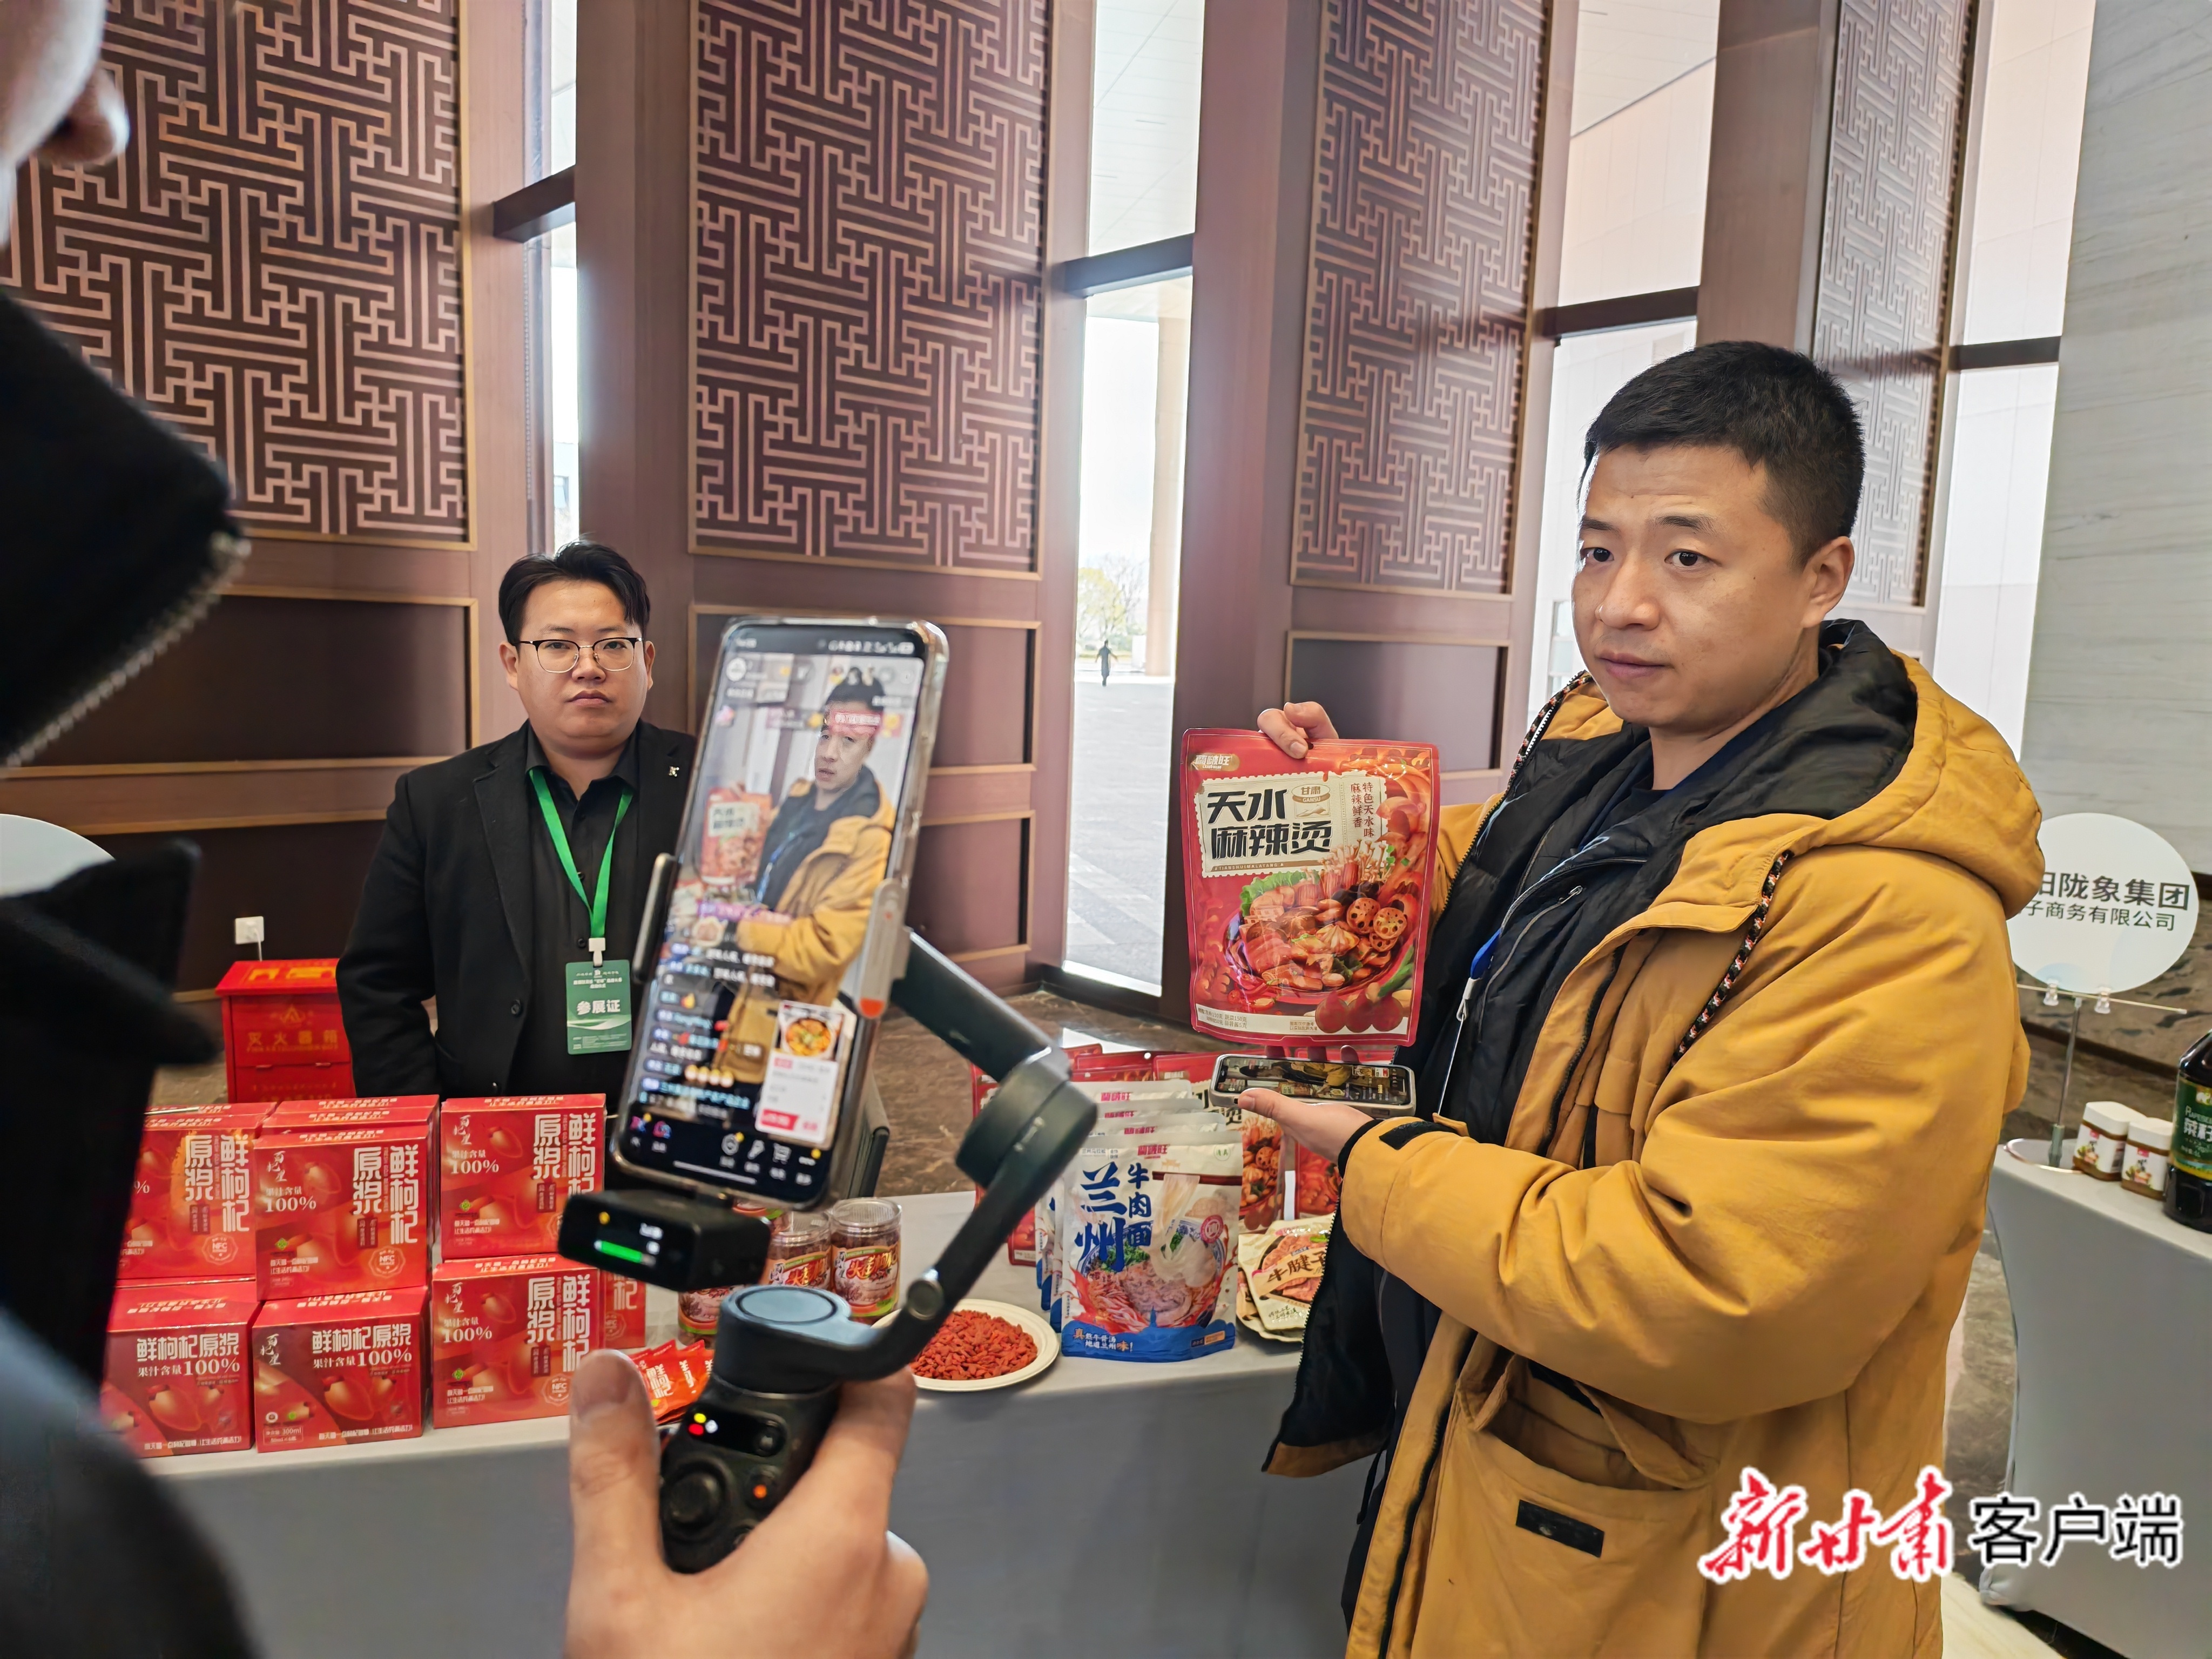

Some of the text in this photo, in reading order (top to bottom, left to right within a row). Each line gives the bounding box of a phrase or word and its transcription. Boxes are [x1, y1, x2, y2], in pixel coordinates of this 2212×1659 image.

[1208, 789, 1287, 824] 天水
[1300, 786, 1321, 795] 甘肃
[1351, 783, 1363, 828] 麻辣鲜香
[1362, 782, 1374, 838] 特色天水味
[1211, 821, 1331, 859] 麻辣烫
[2019, 900, 2175, 931] 子商务有限公司
[577, 1000, 621, 1015] 参展证
[185, 1134, 213, 1201] 原浆
[451, 1160, 499, 1175] 100%
[532, 1114, 561, 1179] 原浆
[568, 1112, 596, 1195] 鲜枸杞
[221, 1134, 249, 1232] 鲜枸杞
[265, 1195, 316, 1212] 100%
[353, 1147, 382, 1215] 原浆
[390, 1144, 419, 1244] 鲜枸杞
[1074, 1162, 1127, 1272] 兰州
[1127, 1162, 1152, 1246] 牛肉面
[527, 1277, 555, 1344] 原浆
[613, 1274, 638, 1310] 杞
[312, 1324, 412, 1354] 鲜枸杞原浆
[443, 1326, 493, 1343] 100%
[563, 1274, 591, 1373] 鲜枸杞
[137, 1333, 239, 1362] 鲜枸杞原浆
